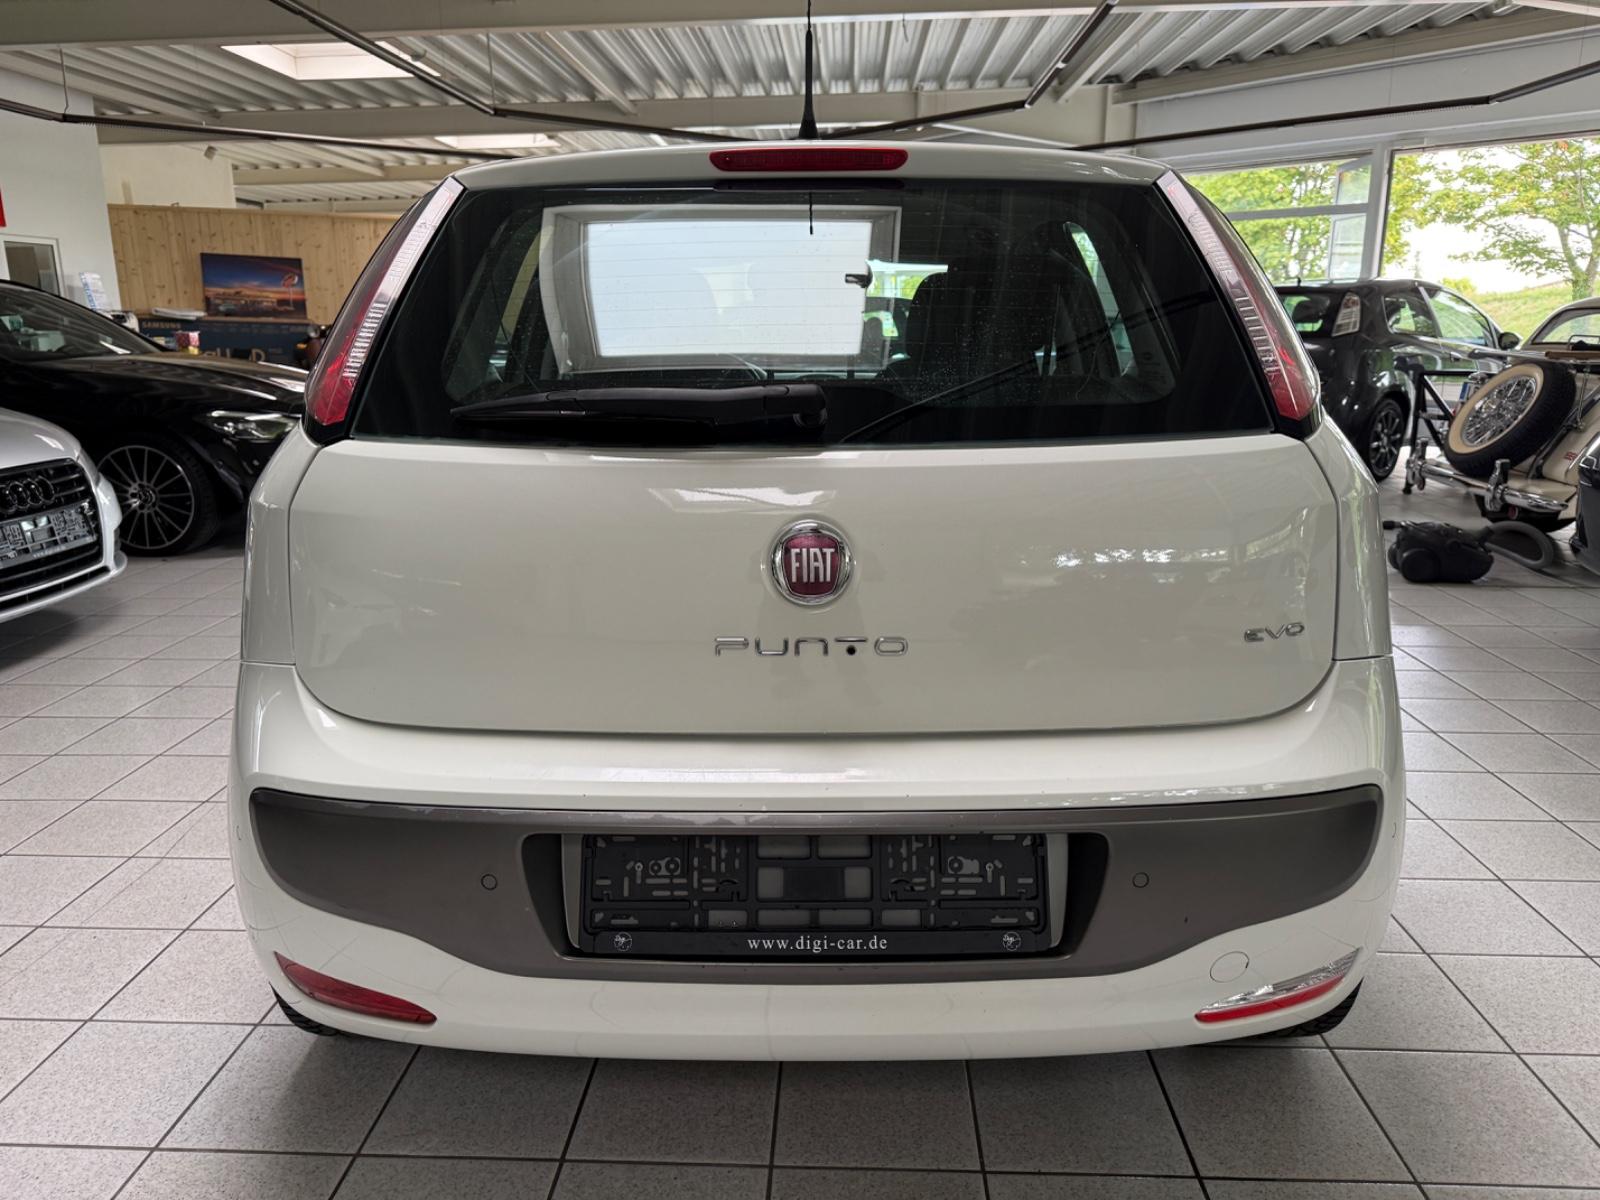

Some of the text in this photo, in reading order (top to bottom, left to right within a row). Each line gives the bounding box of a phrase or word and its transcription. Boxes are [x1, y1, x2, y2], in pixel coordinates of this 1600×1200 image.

[790, 547, 835, 583] FIAT
[1244, 622, 1305, 643] EVO
[715, 637, 908, 657] PUNTO
[747, 935, 888, 953] www.digi-car.de
